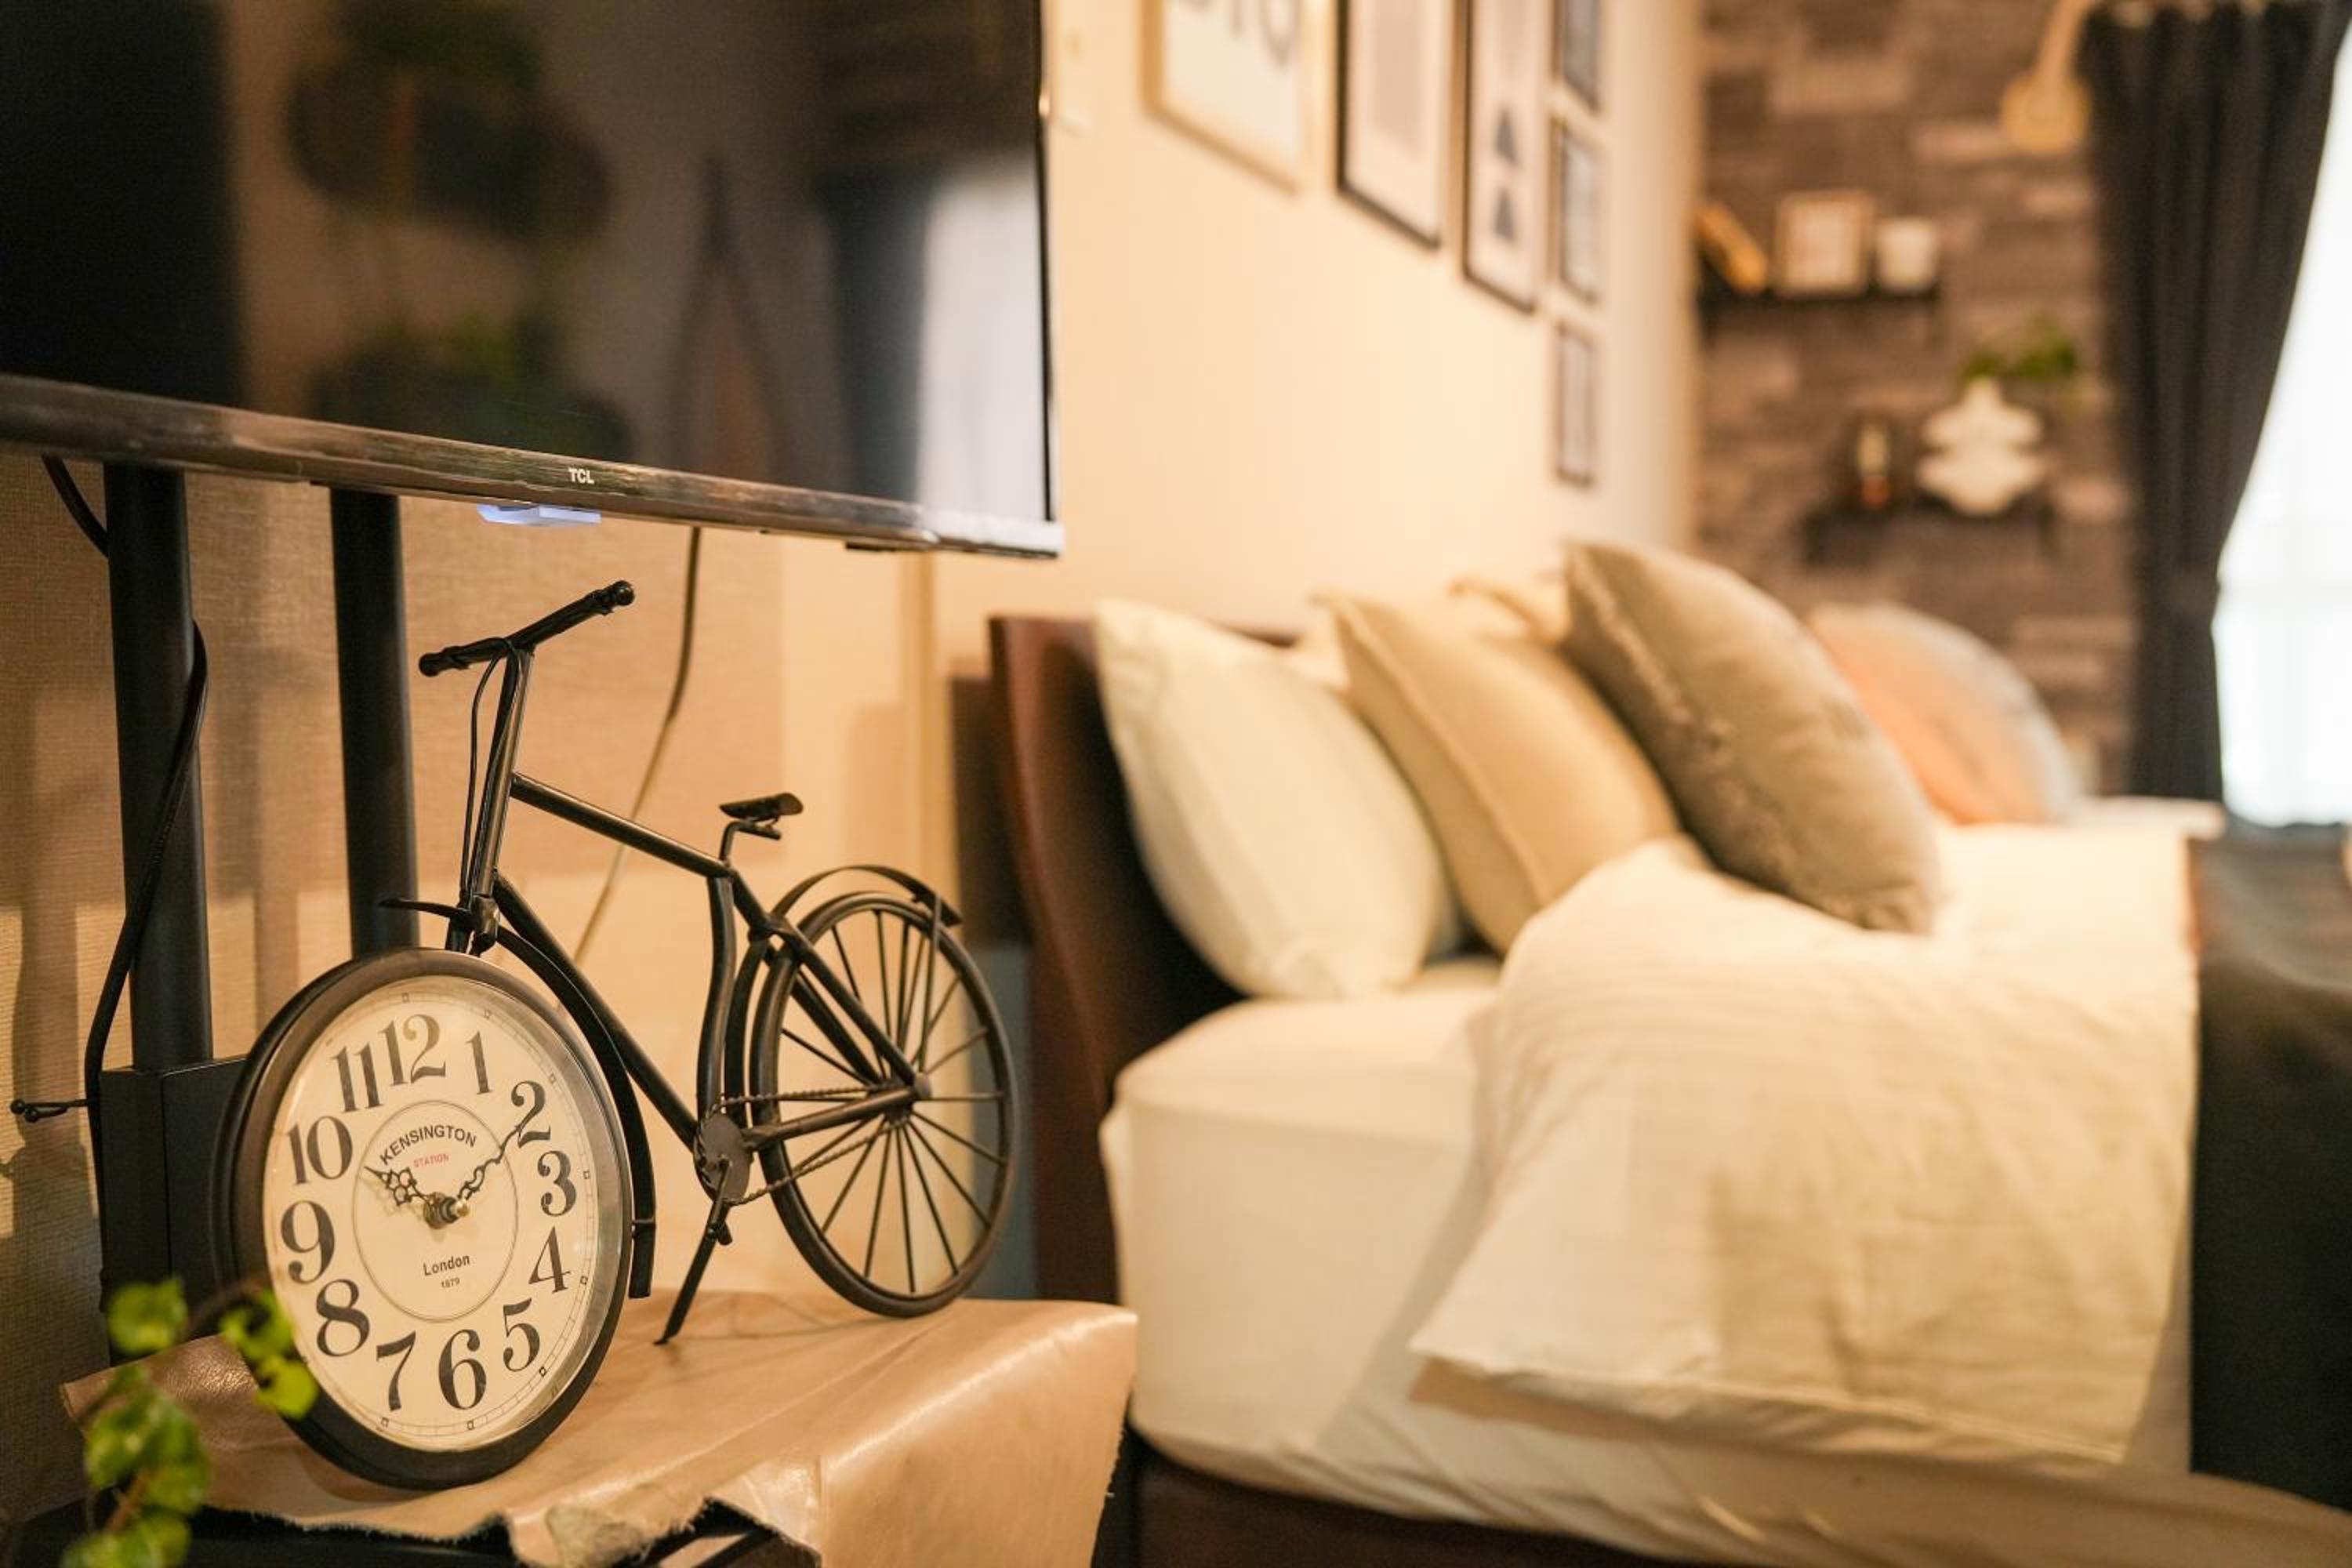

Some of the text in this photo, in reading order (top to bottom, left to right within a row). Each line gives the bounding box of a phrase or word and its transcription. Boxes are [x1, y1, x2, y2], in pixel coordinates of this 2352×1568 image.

[568, 466, 594, 485] TCL
[331, 1044, 382, 1113] 11
[379, 1014, 447, 1086] 12
[466, 1032, 494, 1094] 1
[380, 1124, 477, 1165] KENSINGTON
[510, 1080, 552, 1147] 2
[288, 1115, 353, 1185] 10
[414, 1154, 449, 1167] STATION
[538, 1151, 577, 1216] 3
[281, 1201, 335, 1284] 9
[423, 1254, 470, 1276] London
[528, 1226, 572, 1293] 4
[316, 1279, 369, 1357] 8
[503, 1298, 539, 1372] 5
[376, 1331, 416, 1410] 7
[438, 1329, 487, 1410] 6
